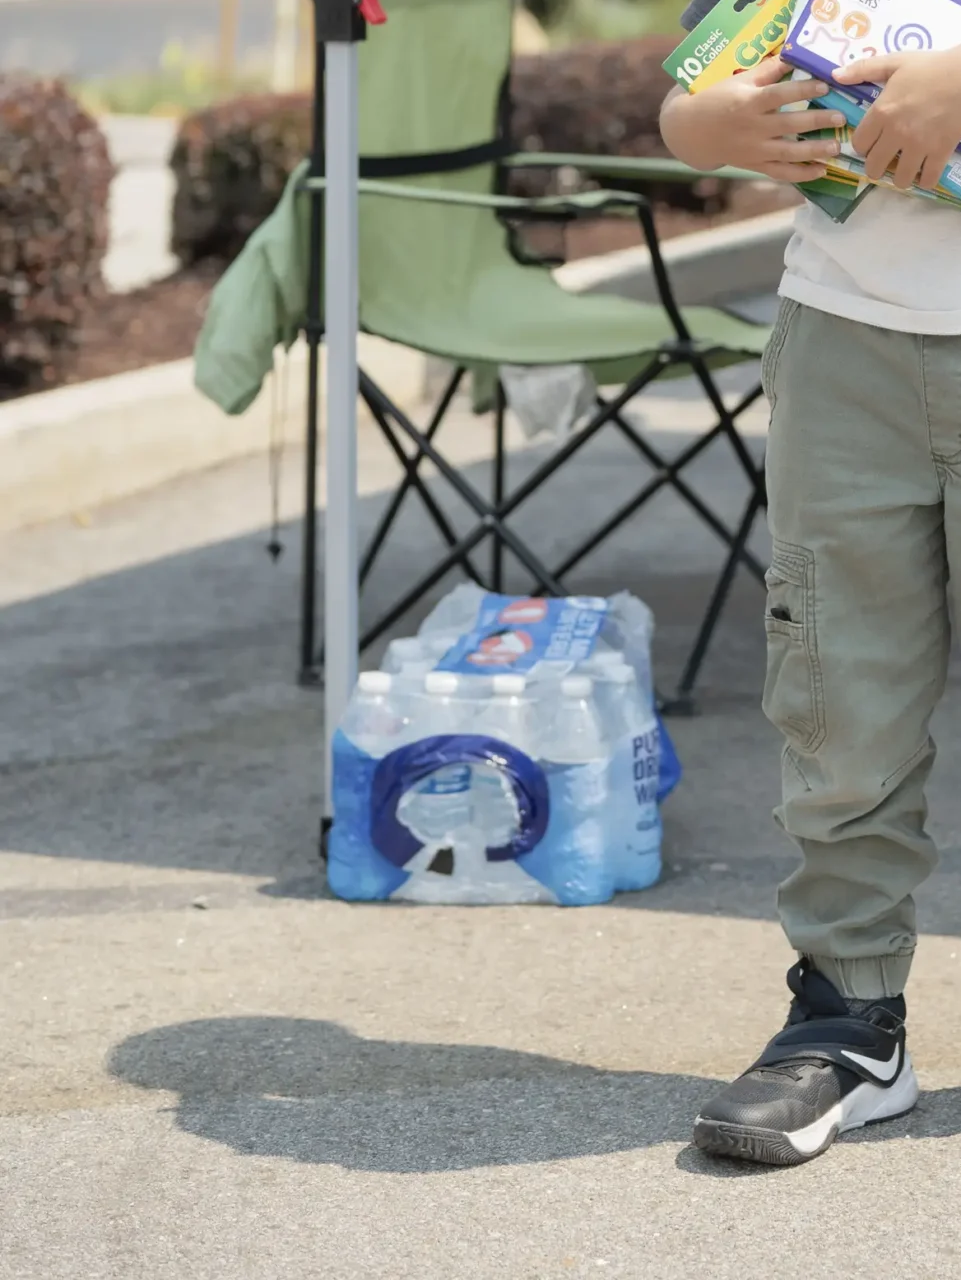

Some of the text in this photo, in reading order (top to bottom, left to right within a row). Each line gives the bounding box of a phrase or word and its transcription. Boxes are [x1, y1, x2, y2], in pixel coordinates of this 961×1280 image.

[694, 27, 723, 57] Classic
[702, 37, 730, 65] Colors
[676, 57, 703, 85] 10
